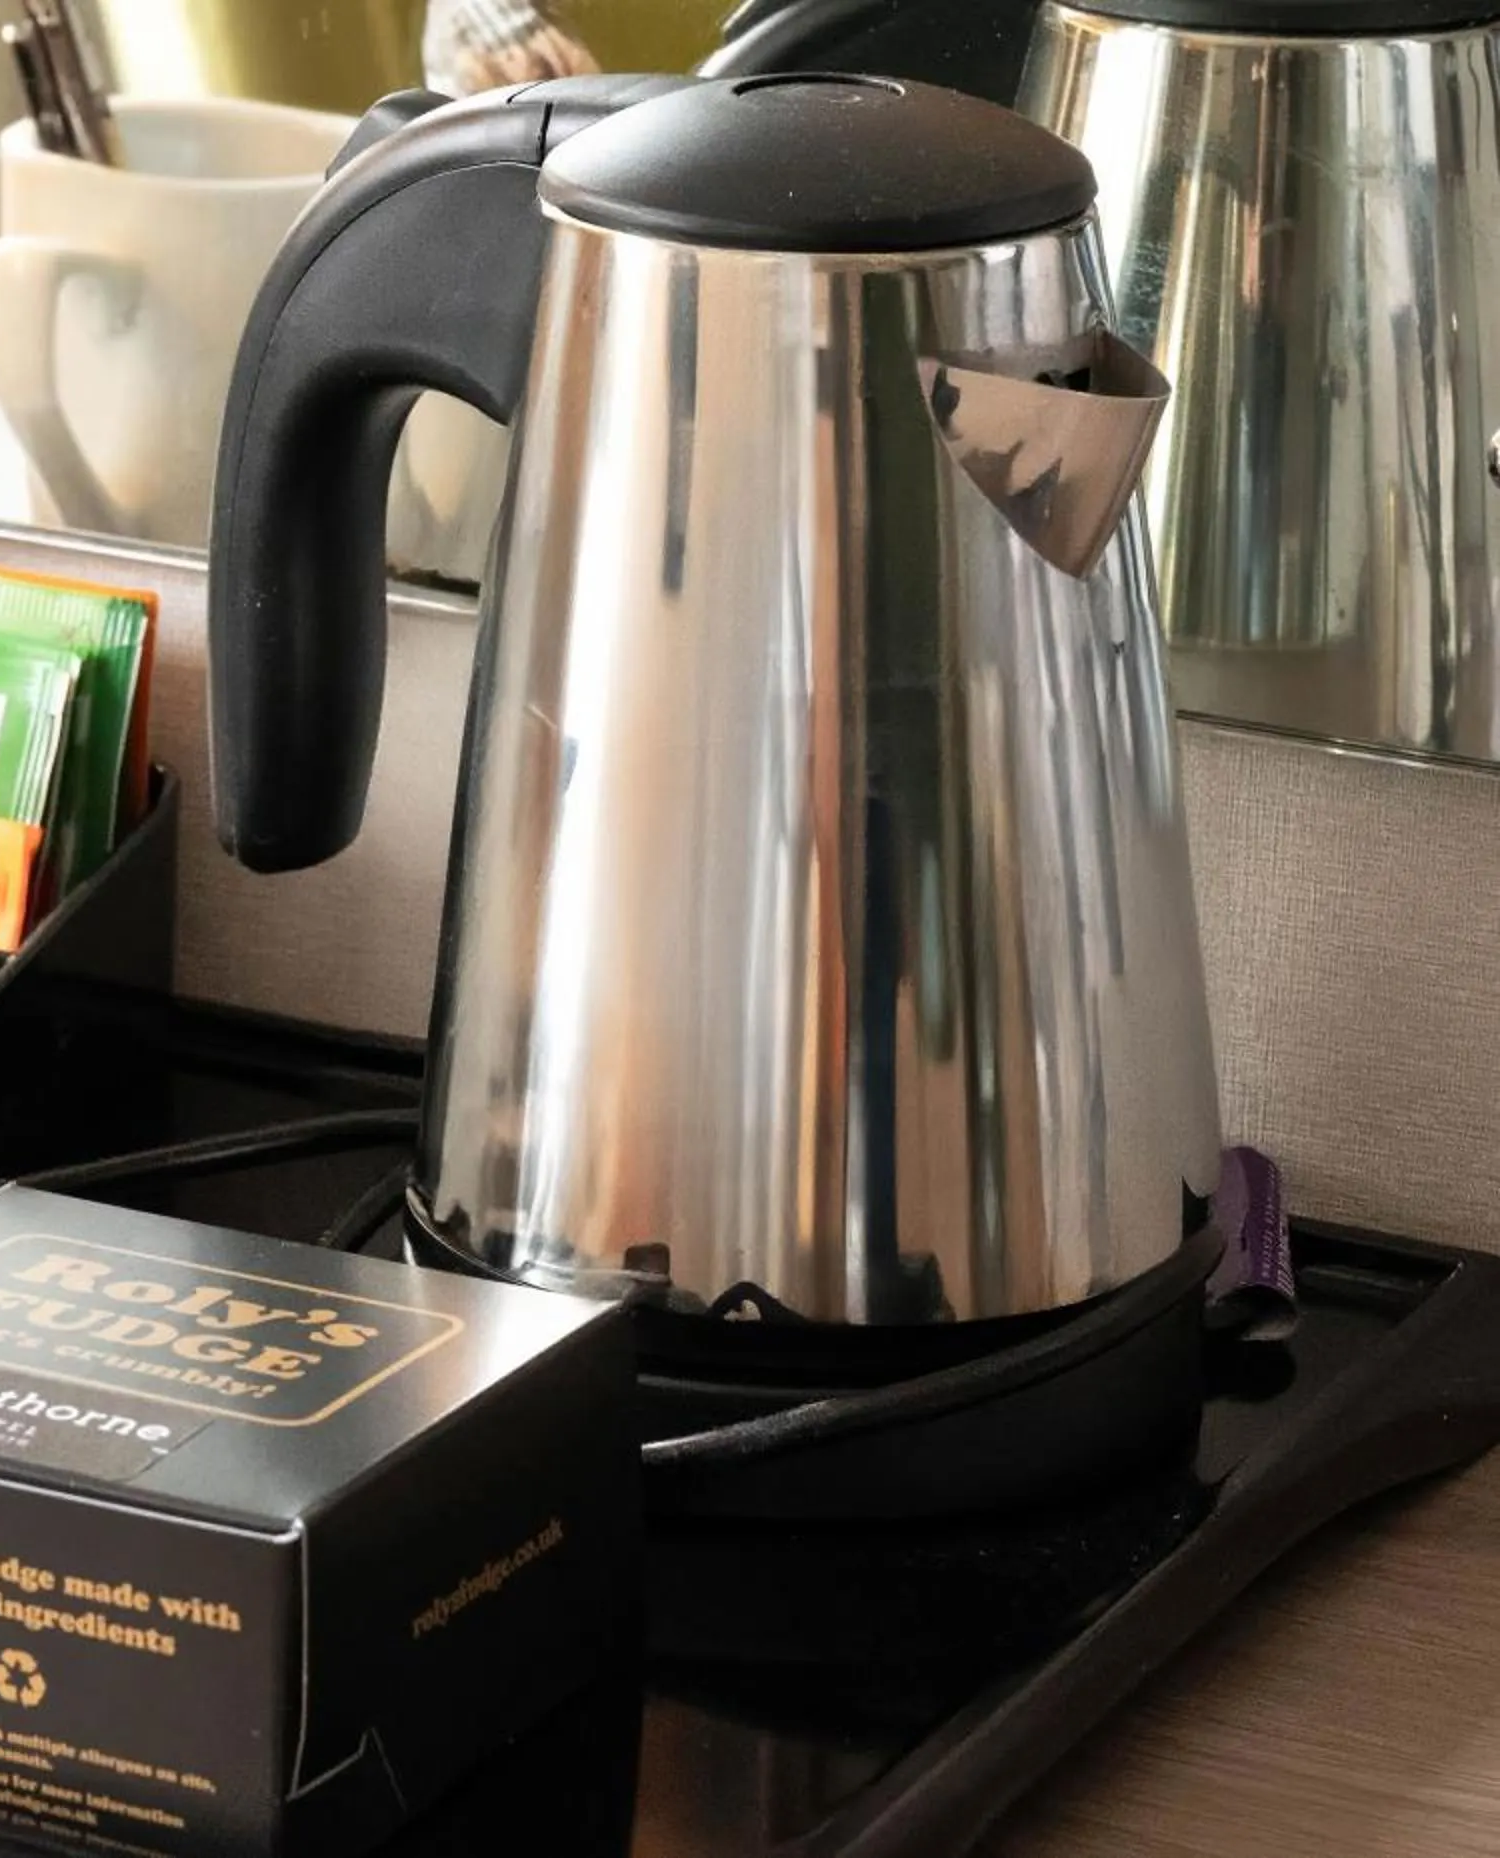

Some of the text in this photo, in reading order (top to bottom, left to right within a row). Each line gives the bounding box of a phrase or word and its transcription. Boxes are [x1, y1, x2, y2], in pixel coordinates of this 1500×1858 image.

[11, 1253, 380, 1348] Roly's
[53, 1343, 278, 1399] crumbly!
[63, 1574, 151, 1611] made
[158, 1595, 242, 1632] with
[7, 1731, 75, 1760] multiple
[79, 1747, 153, 1777] allergens
[156, 1768, 177, 1783] on
[12, 1774, 38, 1792] for
[41, 1783, 83, 1803] more
[86, 1791, 185, 1829] information
